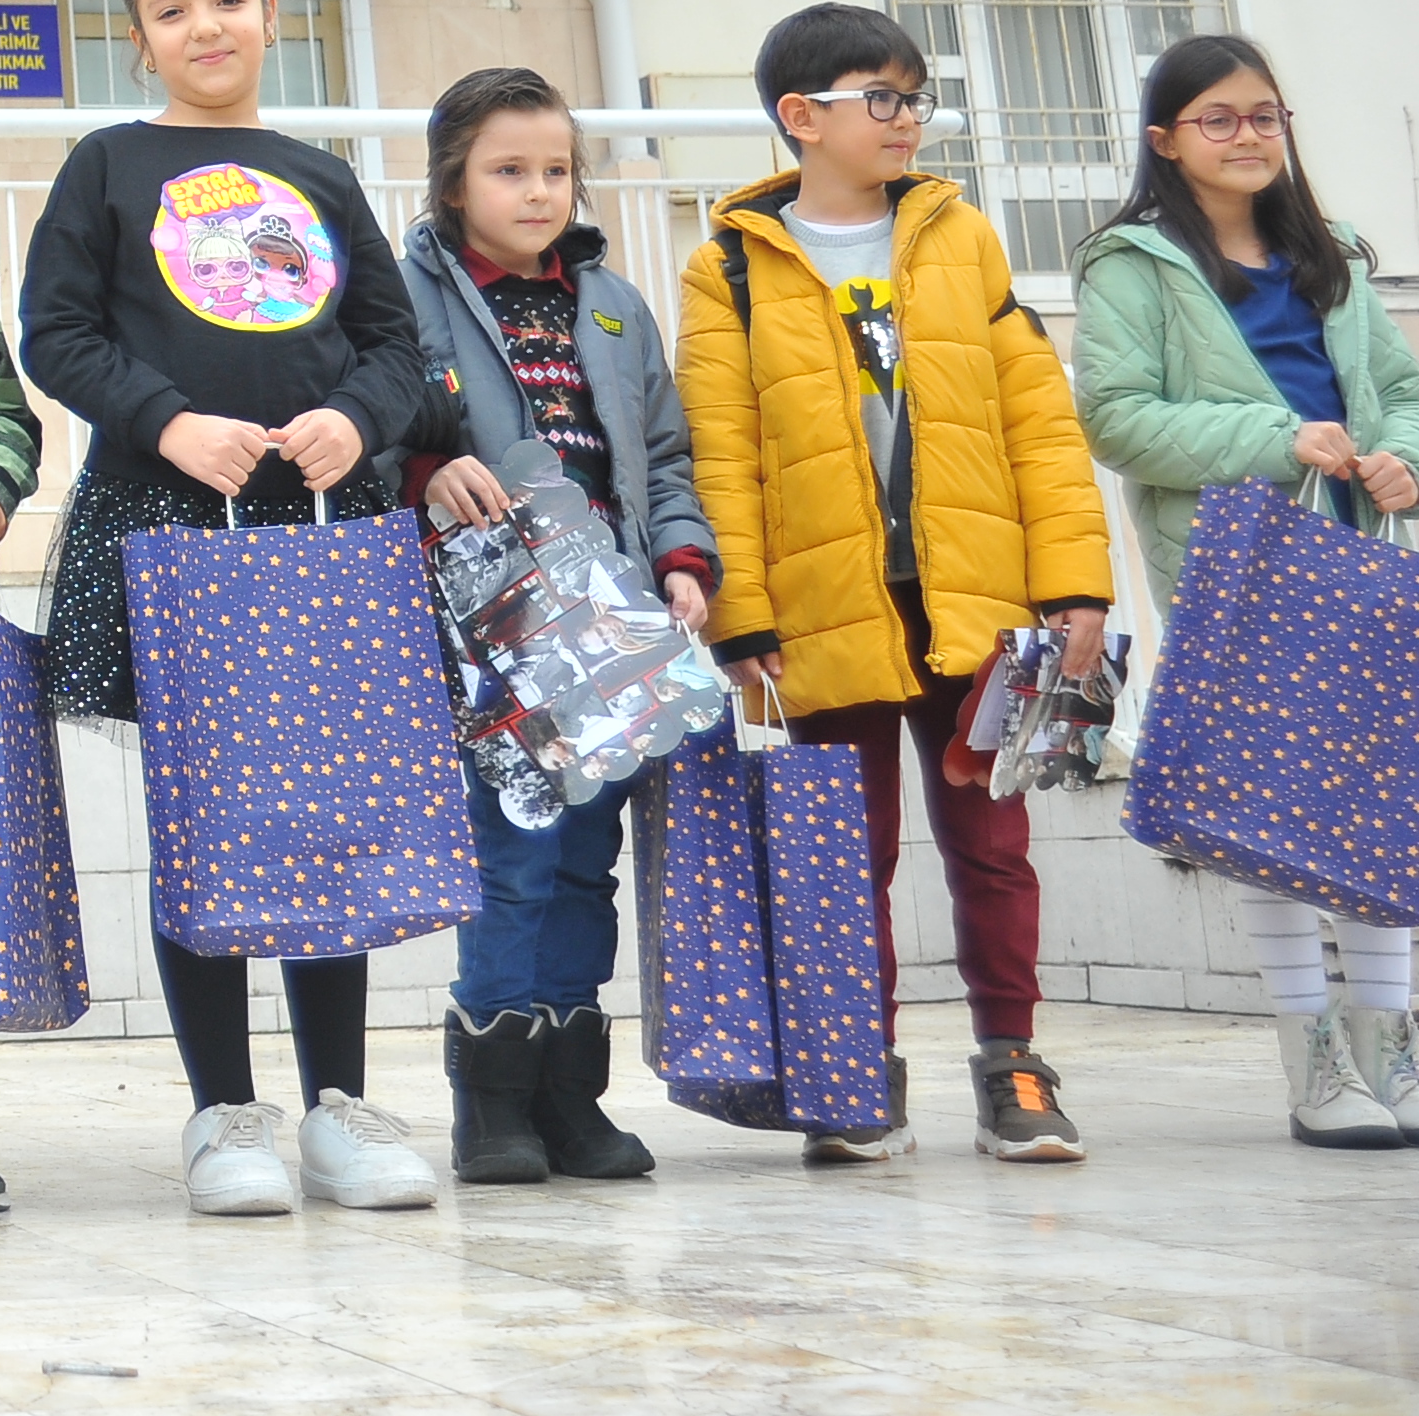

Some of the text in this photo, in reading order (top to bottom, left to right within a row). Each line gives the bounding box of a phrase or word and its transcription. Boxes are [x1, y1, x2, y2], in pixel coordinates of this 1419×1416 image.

[11, 15, 30, 30] VE
[168, 167, 245, 200] EXTRA
[174, 184, 262, 219] FLAVOR
